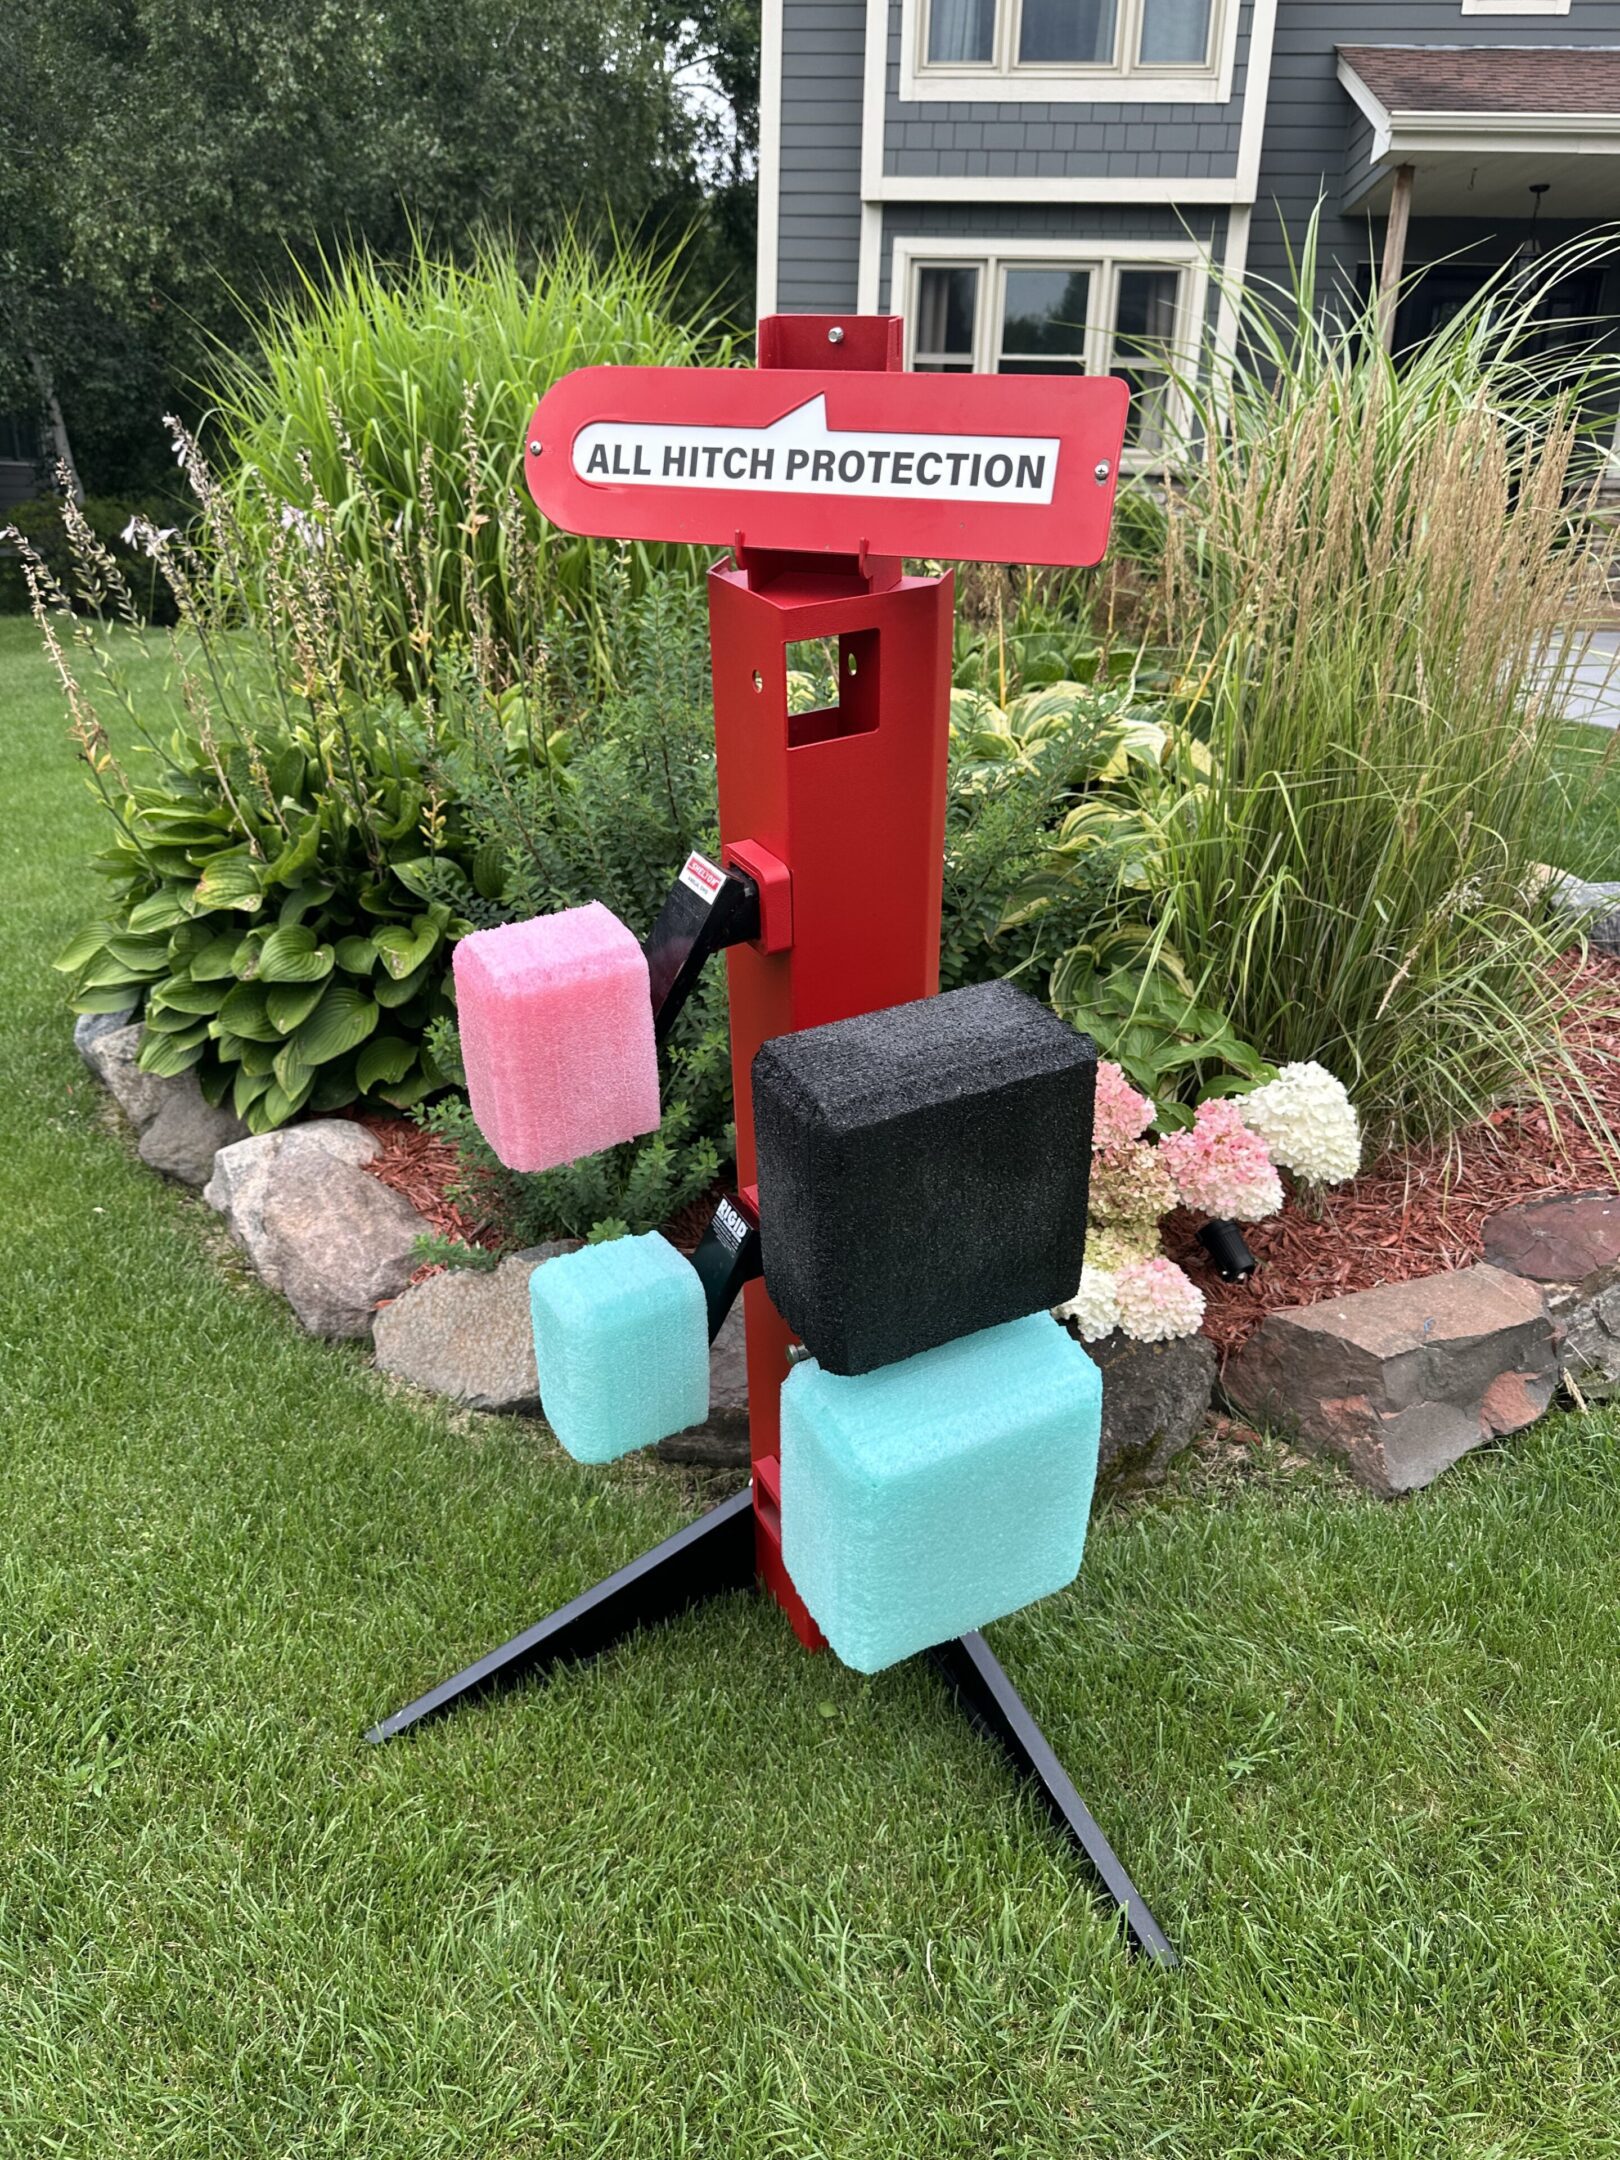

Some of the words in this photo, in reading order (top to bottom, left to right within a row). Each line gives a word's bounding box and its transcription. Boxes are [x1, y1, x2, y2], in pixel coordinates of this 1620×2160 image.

[586, 443, 651, 476] ALL
[661, 446, 775, 480] HITCH
[785, 448, 1046, 488] PROTECTION
[716, 1198, 747, 1238] RIGID
